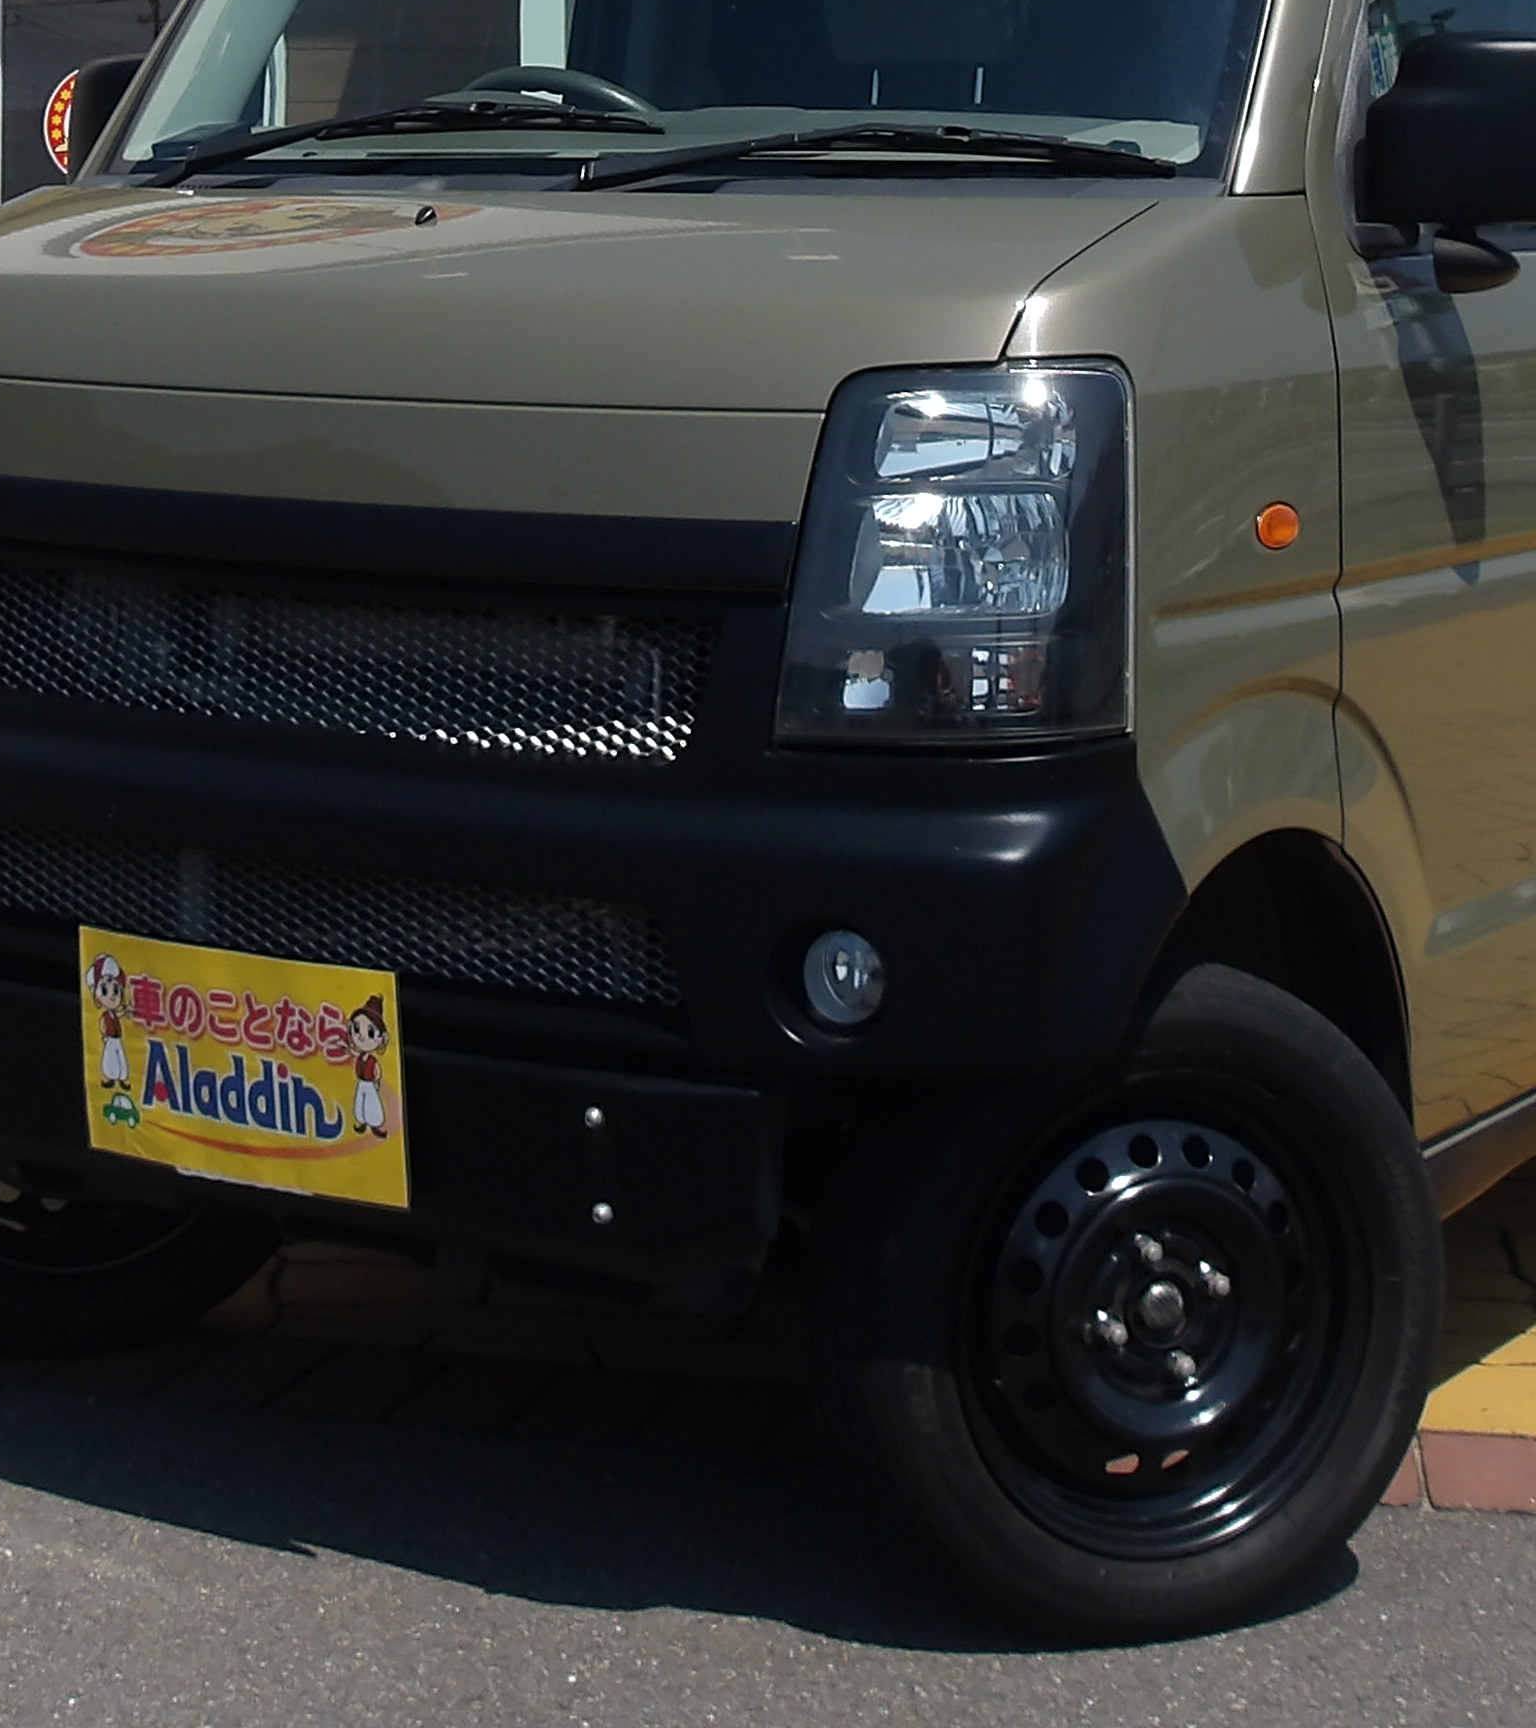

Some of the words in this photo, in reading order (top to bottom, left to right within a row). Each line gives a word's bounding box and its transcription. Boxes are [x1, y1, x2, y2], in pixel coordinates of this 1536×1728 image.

[128, 974, 356, 1065] 車のことなら
[142, 1038, 344, 1143] Aladdin
